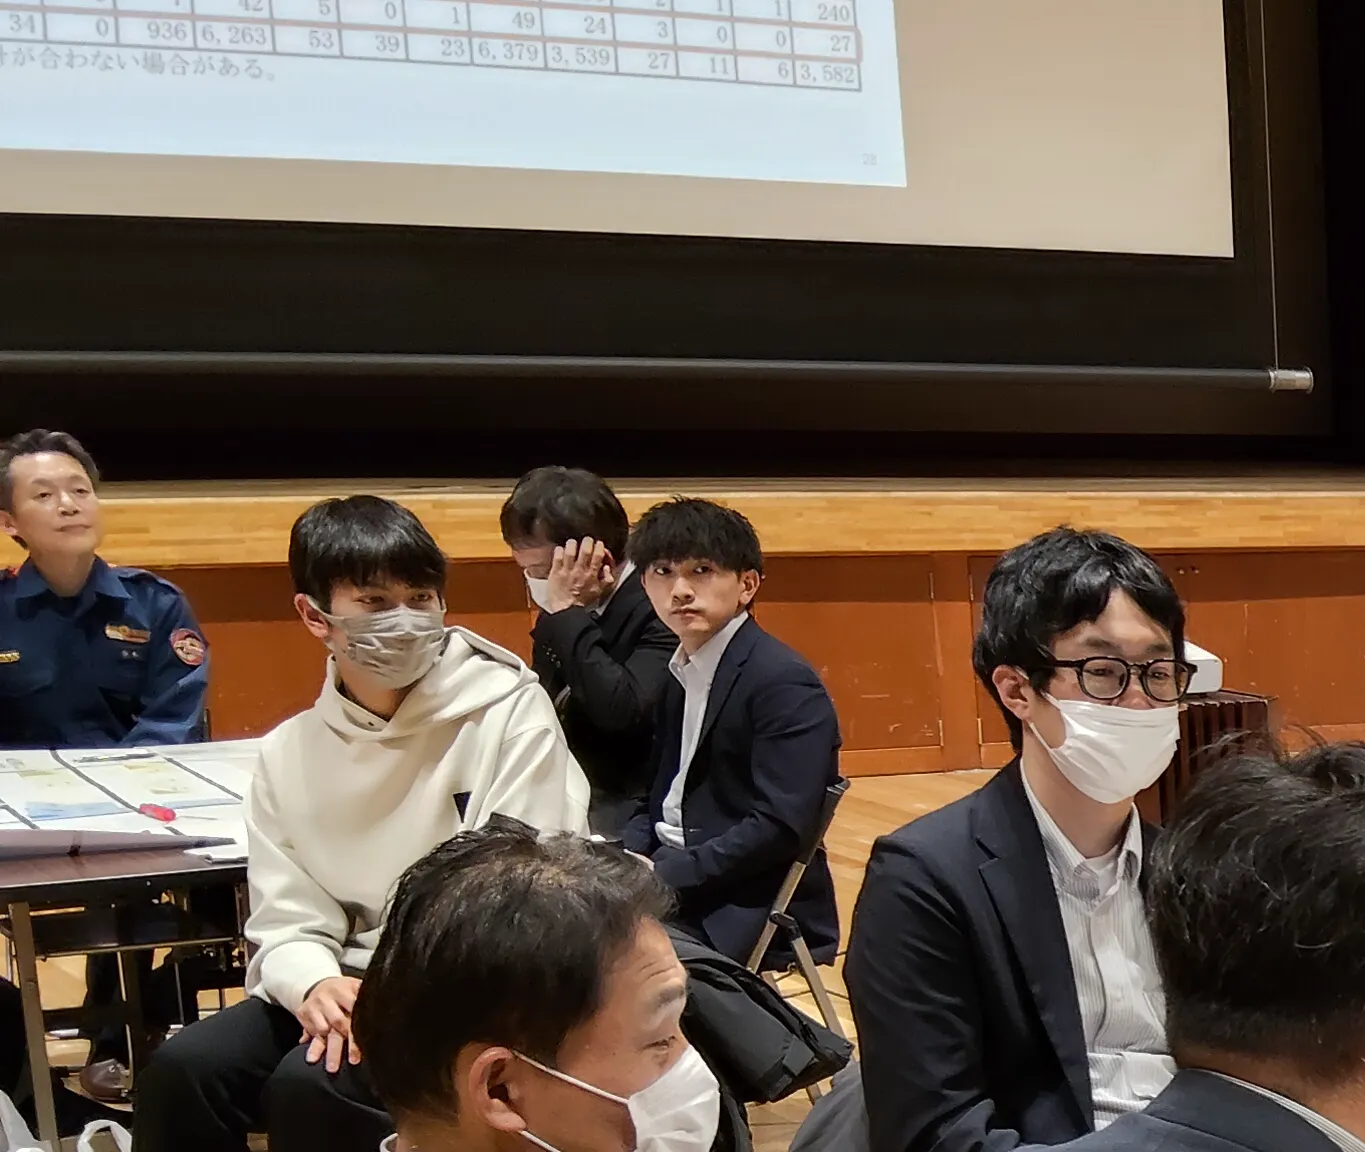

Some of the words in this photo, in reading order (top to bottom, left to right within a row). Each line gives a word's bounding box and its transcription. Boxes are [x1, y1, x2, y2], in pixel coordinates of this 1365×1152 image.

[319, 0, 331, 15] 5
[385, 2, 397, 19] 0
[451, 6, 460, 24] 1
[512, 11, 535, 29] 49
[584, 17, 607, 35] 24
[657, 20, 669, 39] 3
[716, 25, 728, 43] 0
[776, 29, 787, 48] 0
[830, 34, 852, 53] 27
[817, 4, 851, 22] 240
[9, 13, 36, 34] 34
[96, 17, 109, 37] 0
[147, 21, 188, 41] 936
[202, 24, 268, 46] 6,263
[308, 30, 335, 50] 53
[375, 34, 401, 53] 39
[441, 38, 465, 57] 23
[478, 41, 538, 63] 6,379
[551, 45, 611, 67] 3,539
[647, 52, 670, 71] 27
[709, 57, 730, 76] 11
[778, 61, 789, 79] 6
[800, 63, 856, 85] 3,582
